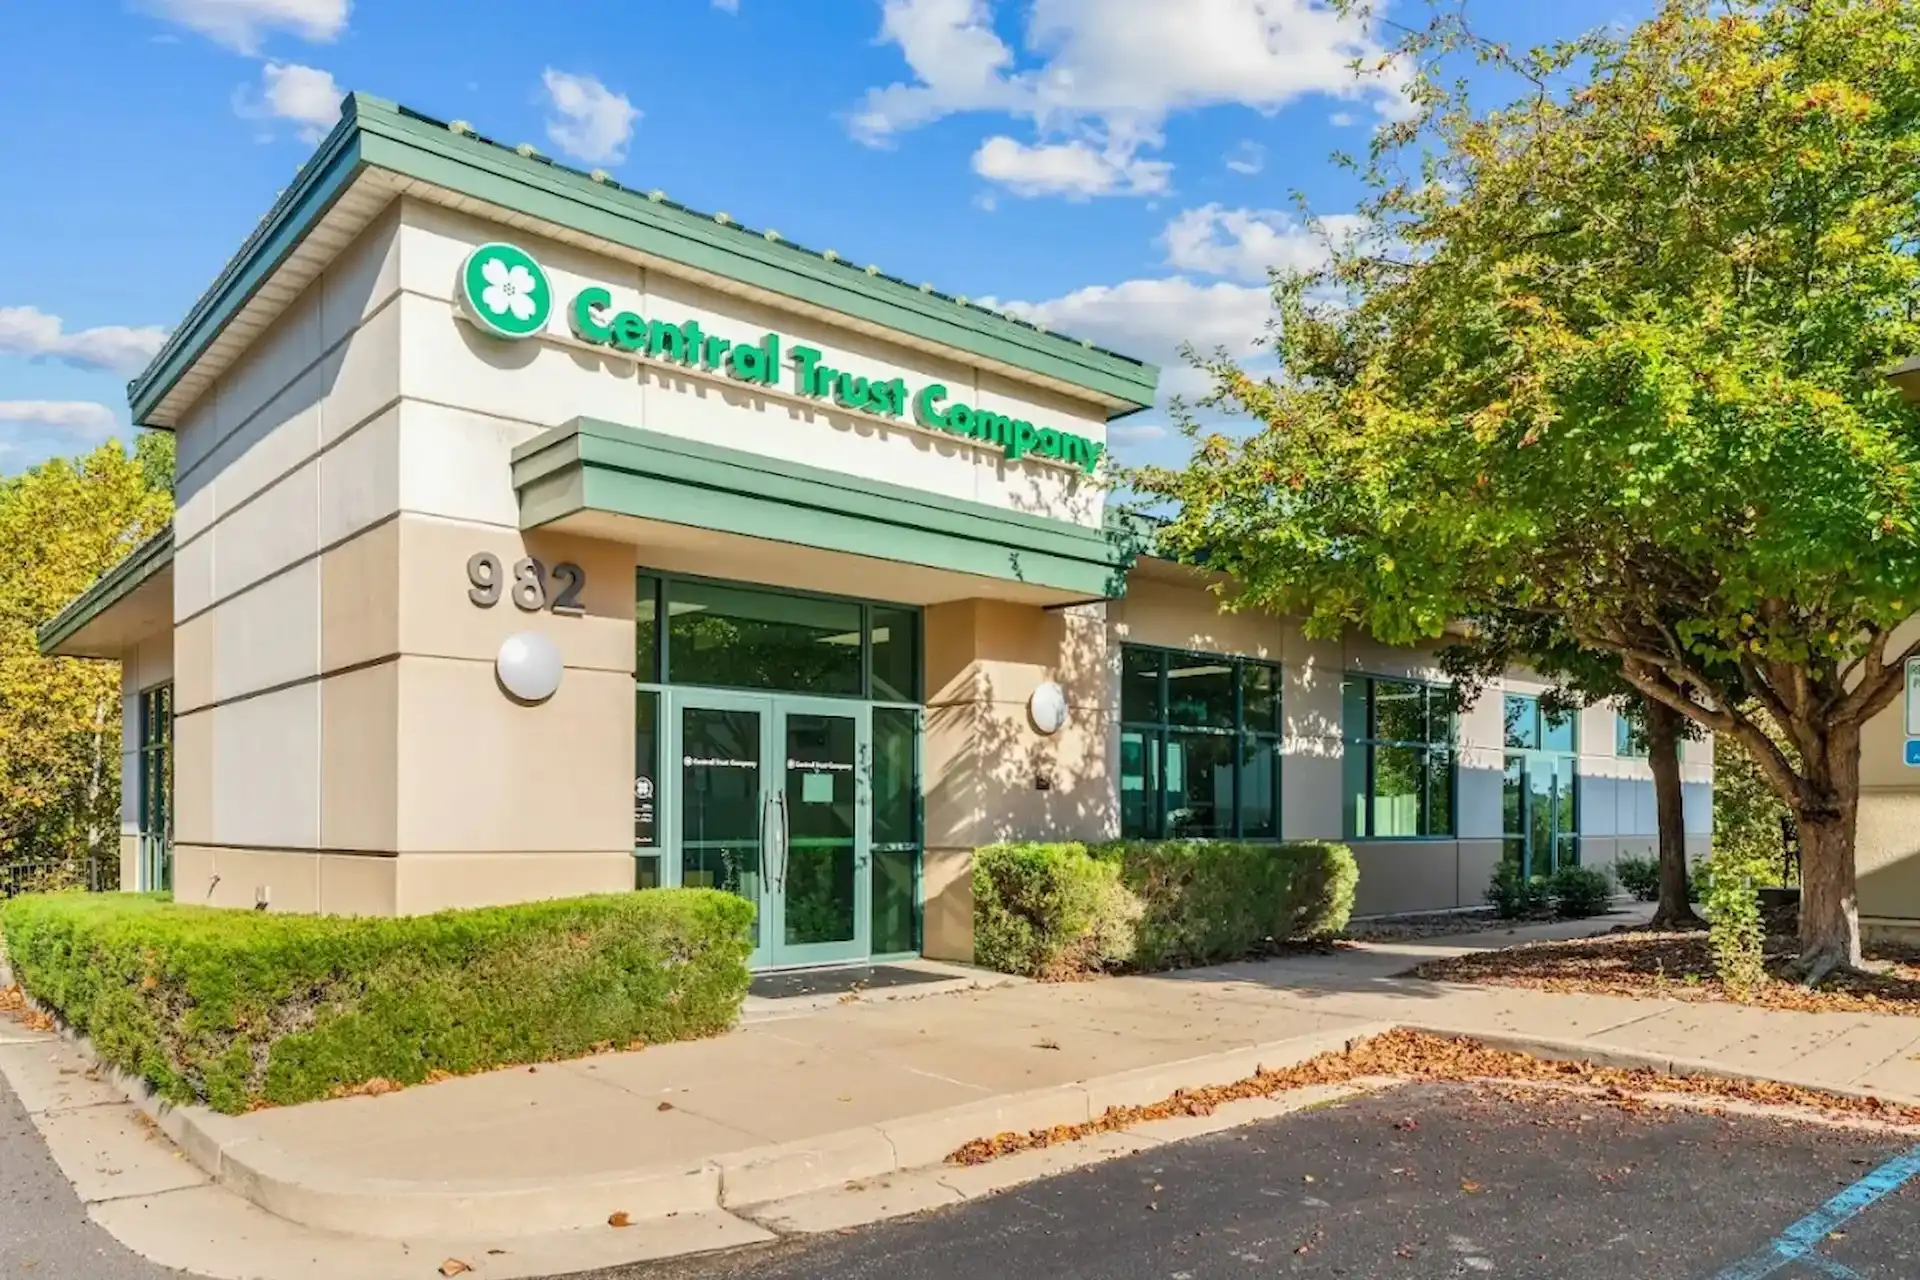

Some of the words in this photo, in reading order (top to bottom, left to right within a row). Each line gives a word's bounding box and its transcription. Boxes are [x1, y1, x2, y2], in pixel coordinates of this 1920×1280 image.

[568, 287, 779, 387] Central
[787, 344, 908, 418] Trust
[913, 384, 1104, 474] Company
[467, 551, 586, 619] 982
